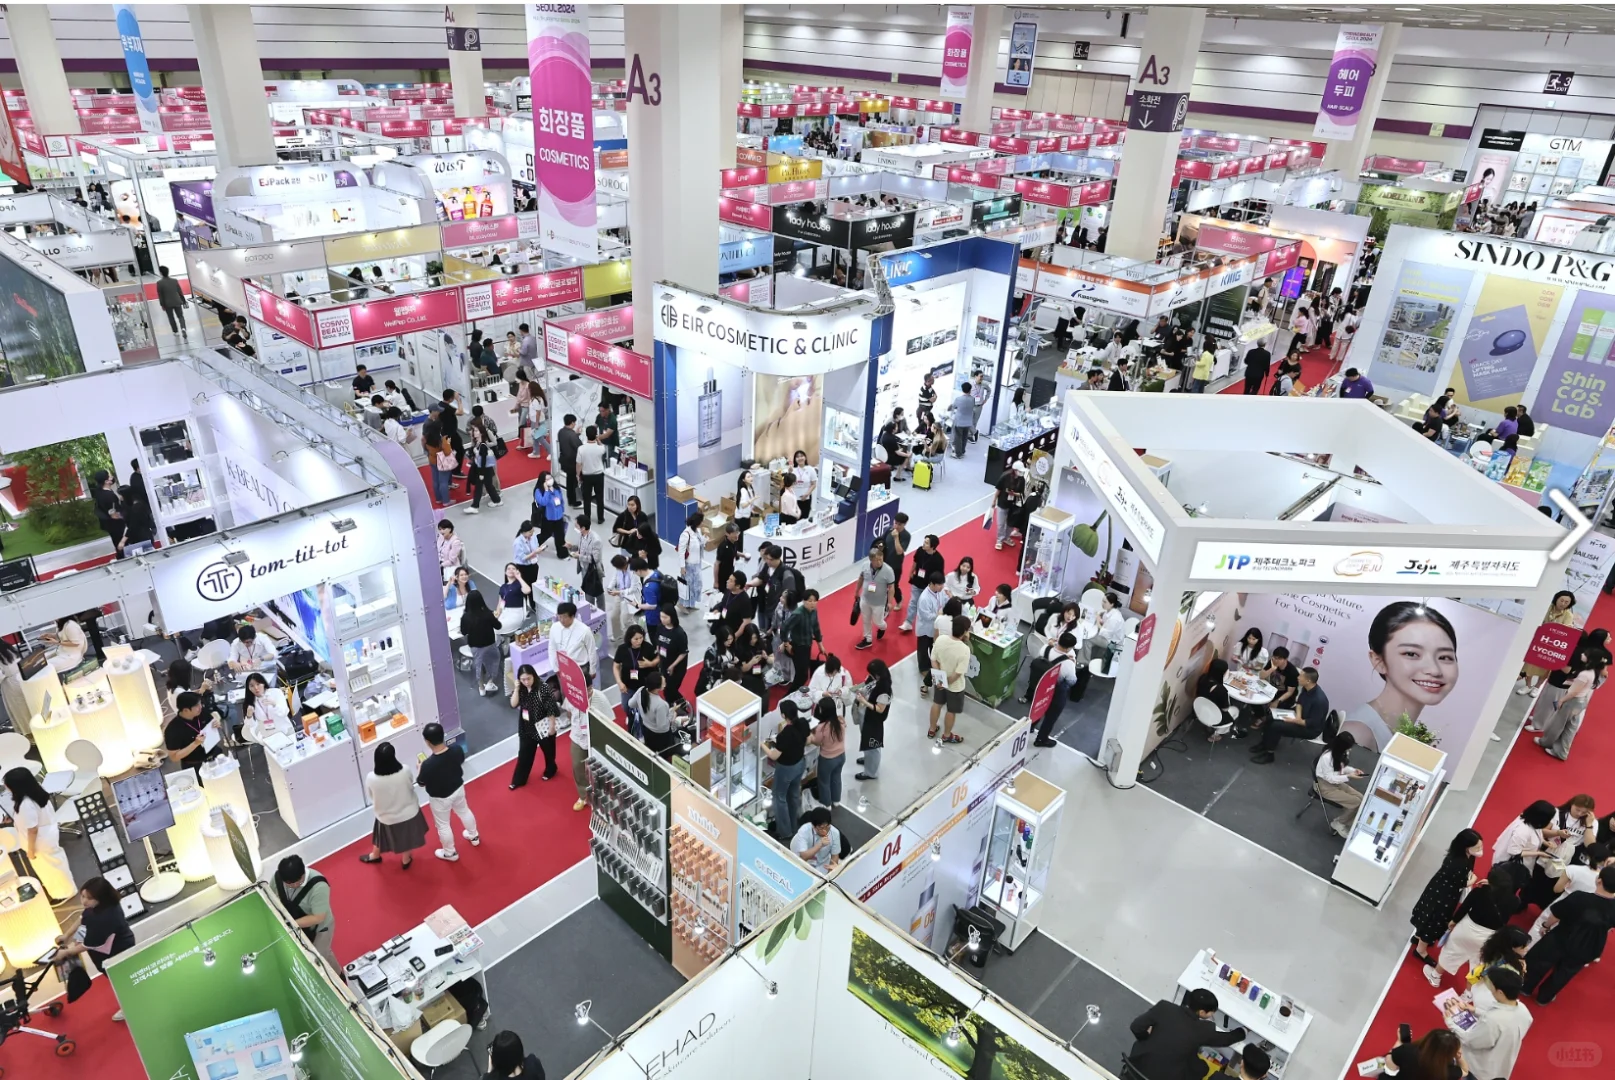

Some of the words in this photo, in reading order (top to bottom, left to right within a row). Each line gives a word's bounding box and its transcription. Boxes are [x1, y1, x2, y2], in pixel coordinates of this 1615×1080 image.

[536, 4, 558, 14] SEOUL
[557, 4, 576, 14] 2024
[947, 47, 967, 59] 화장품
[1138, 54, 1170, 85] A3
[1337, 68, 1360, 81] 헤어
[626, 53, 662, 106] A3
[1564, 77, 1572, 86] 3
[1333, 85, 1354, 98] 두피
[1138, 95, 1161, 105] 소화전
[539, 106, 586, 141] 화장품
[1549, 138, 1583, 152] GTM
[539, 147, 590, 171] COSMETICS
[1454, 239, 1546, 271] SINDO
[1549, 252, 1615, 282] P&G
[466, 294, 491, 304] COSMO
[466, 300, 491, 308] BEAUTY
[320, 316, 350, 328] COSMO
[321, 323, 350, 335] BEAUTY
[548, 335, 568, 347] COSMO
[682, 318, 704, 334] EIR
[709, 321, 788, 355] COSMETIC
[794, 338, 807, 355] &
[811, 328, 858, 354] CLINIC
[548, 341, 568, 354] BEAUTY
[1490, 365, 1508, 375] PACK
[1551, 398, 1596, 420] Lab
[368, 499, 383, 509] G-01
[1589, 539, 1607, 549] H-10
[249, 534, 349, 579] tom-tit-tot
[801, 536, 836, 568] EIR
[1215, 554, 1251, 571] JTP
[1254, 556, 1316, 568] 제주테크노파크
[1356, 563, 1383, 573] JEJU
[1404, 558, 1437, 575] Jeju
[1449, 560, 1520, 573] 제주특별자치도
[1274, 598, 1290, 611] For
[1292, 604, 1314, 619] Your
[1316, 612, 1337, 628] Skin
[1298, 596, 1352, 621] Cosmetics
[1540, 634, 1569, 650] H-08
[1532, 645, 1567, 662] LYCORIS
[1011, 730, 1028, 758] 06
[952, 779, 970, 809] 05
[882, 834, 902, 866] 04
